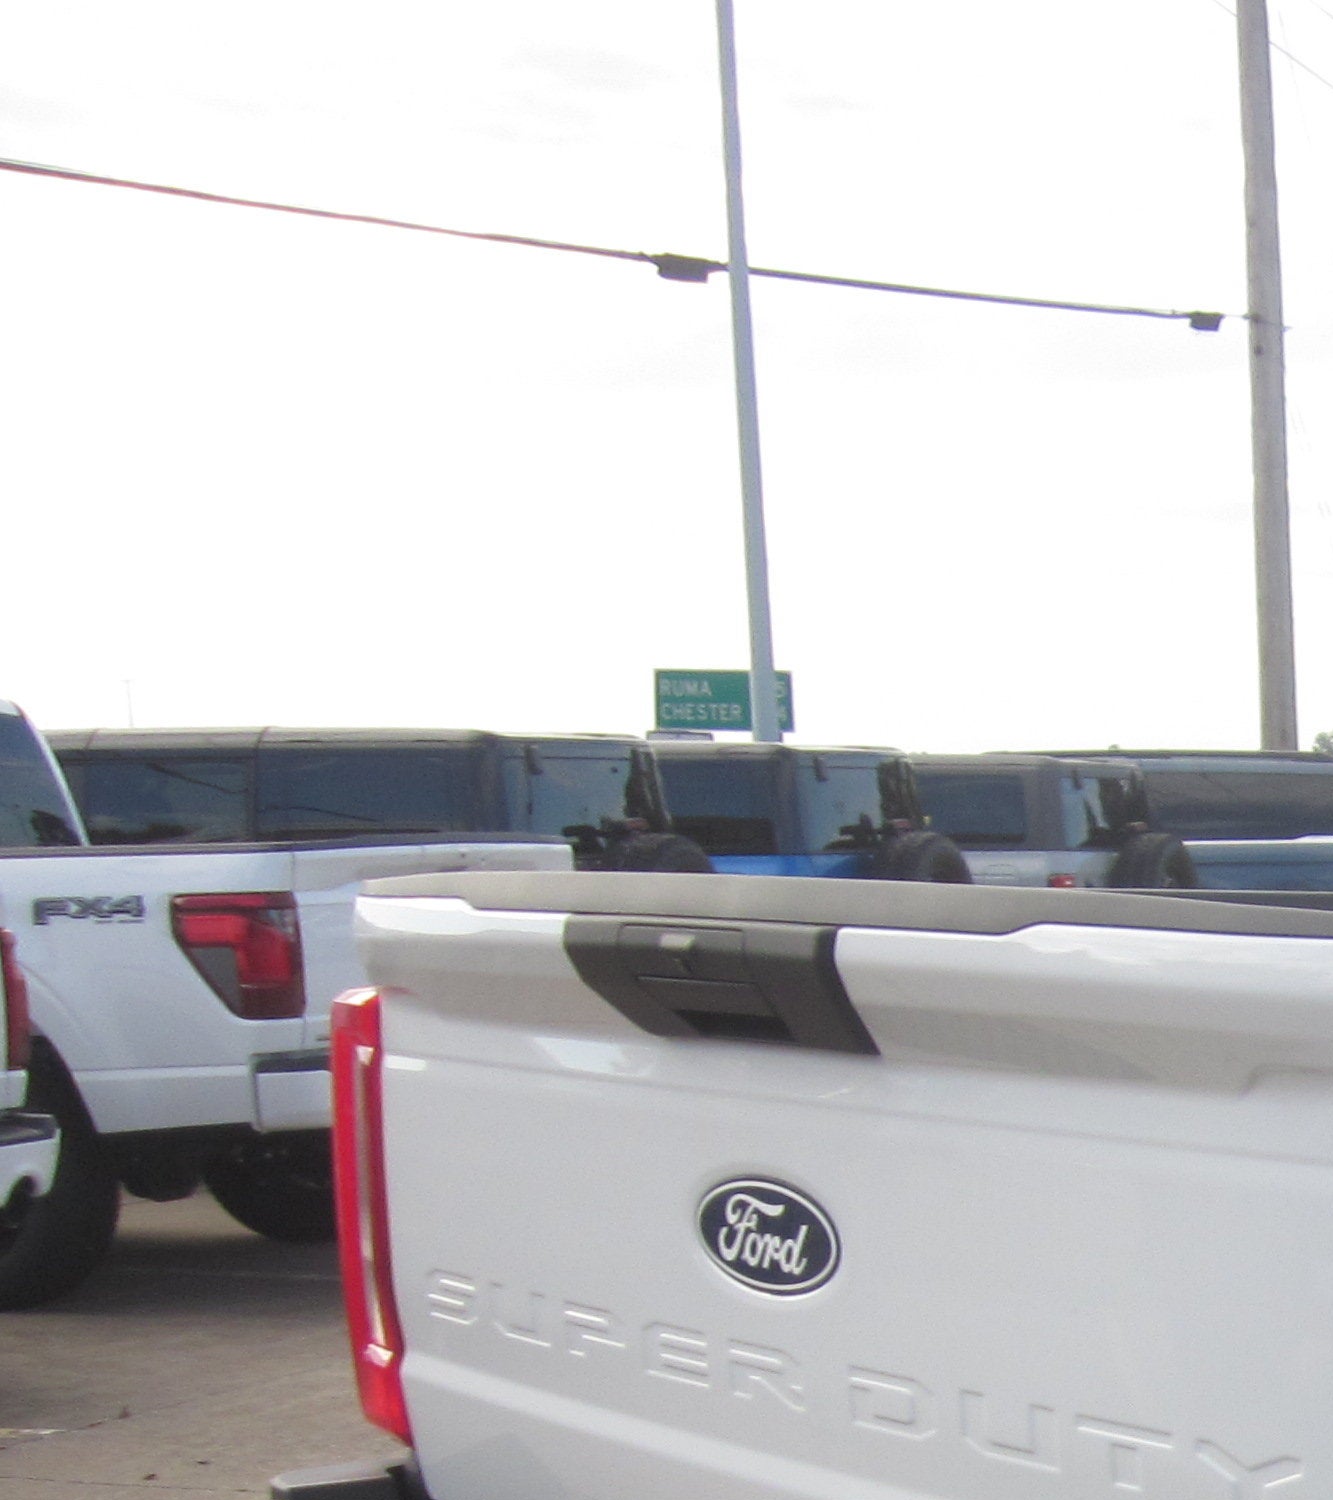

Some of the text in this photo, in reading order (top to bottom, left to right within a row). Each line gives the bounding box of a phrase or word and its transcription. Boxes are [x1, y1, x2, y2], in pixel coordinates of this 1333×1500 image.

[659, 678, 712, 697] RUMA
[661, 702, 743, 721] CHESTER
[32, 895, 147, 925] FX4
[718, 1193, 809, 1275] Ford
[426, 1268, 807, 1414] SUPER
